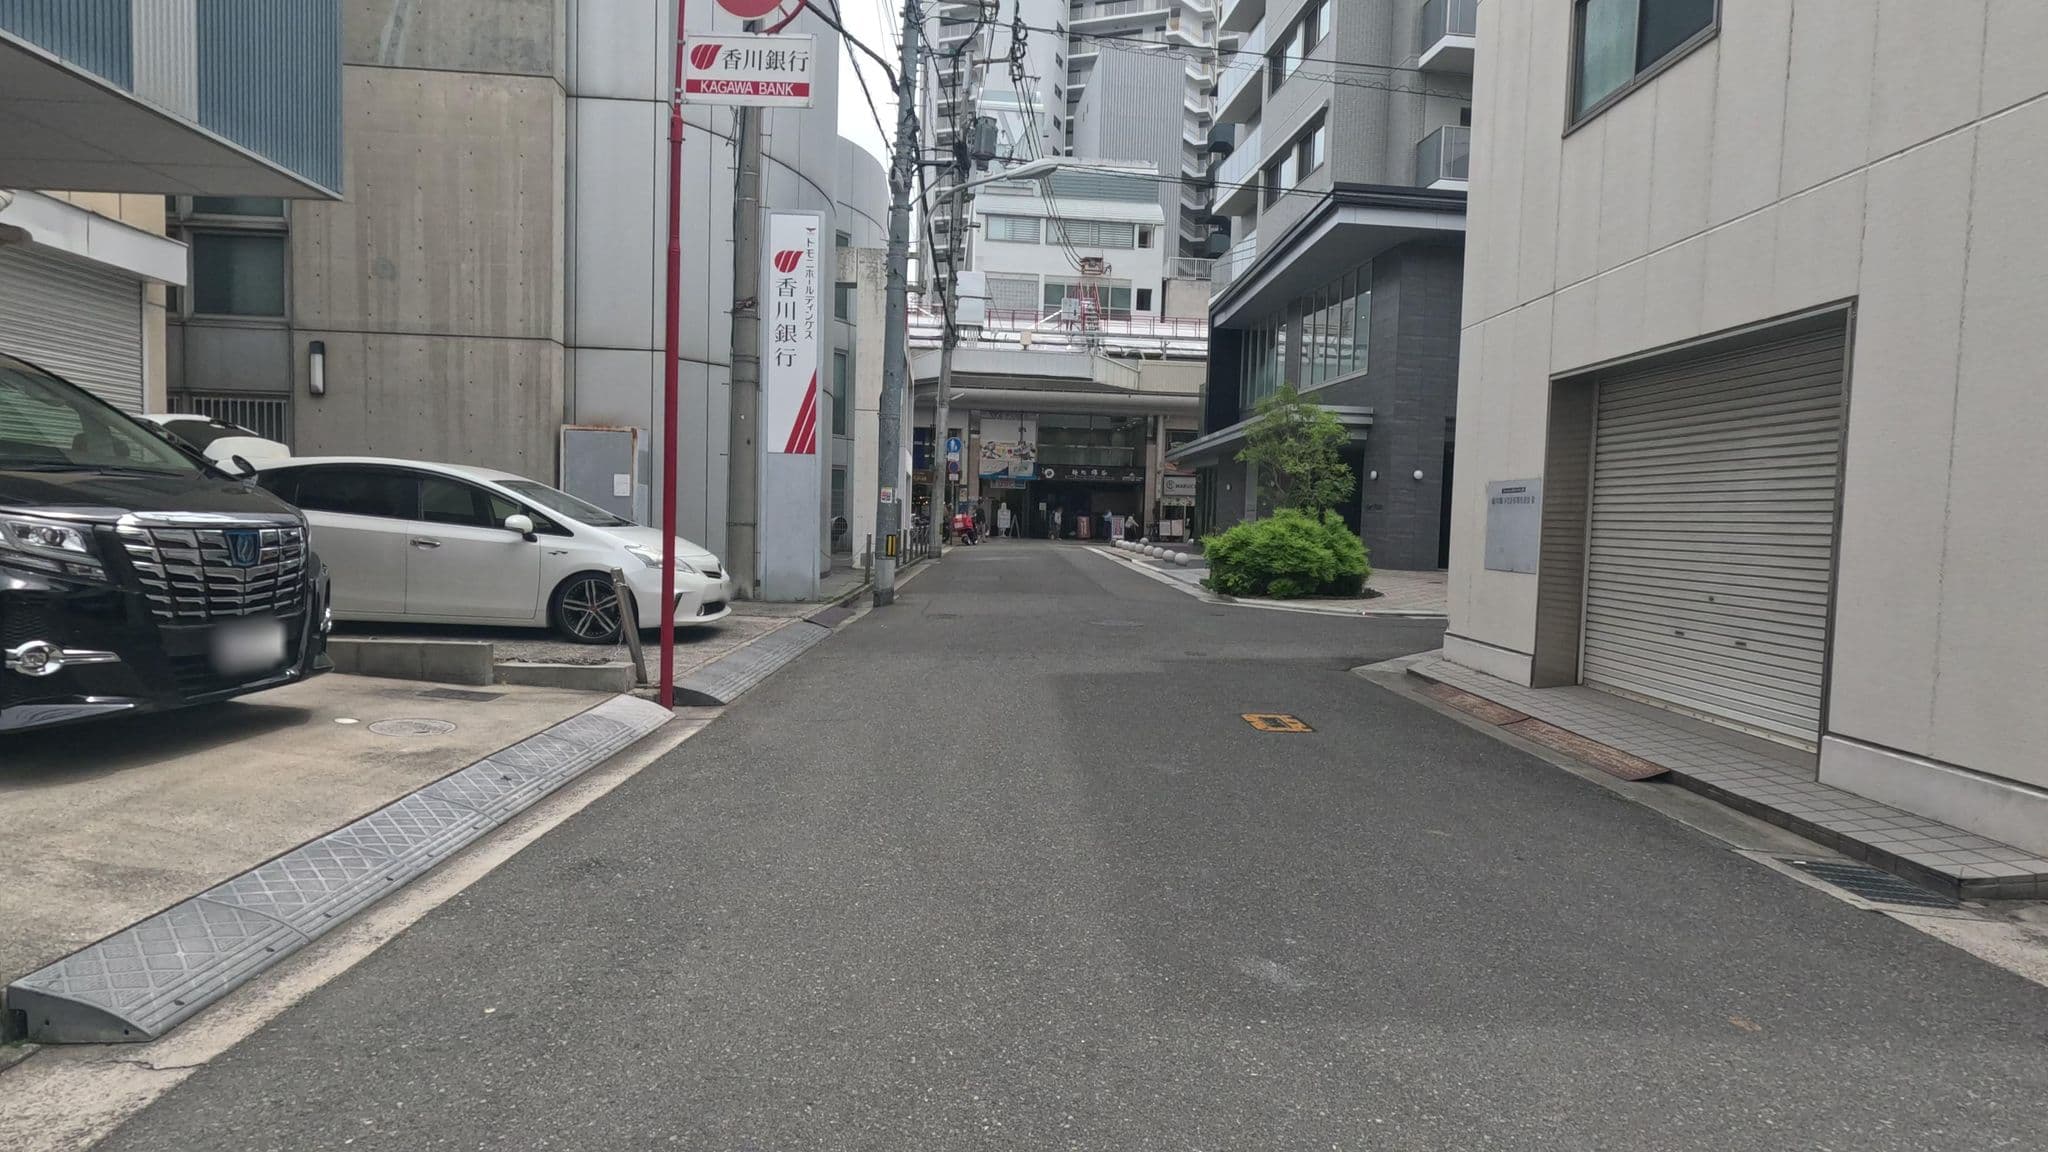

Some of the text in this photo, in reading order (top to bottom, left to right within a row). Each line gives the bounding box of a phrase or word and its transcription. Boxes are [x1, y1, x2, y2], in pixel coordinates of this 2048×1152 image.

[722, 48, 809, 72] 香川銀行
[700, 81, 794, 96] KAGAWA BANK
[775, 277, 797, 368] 香川銀行
